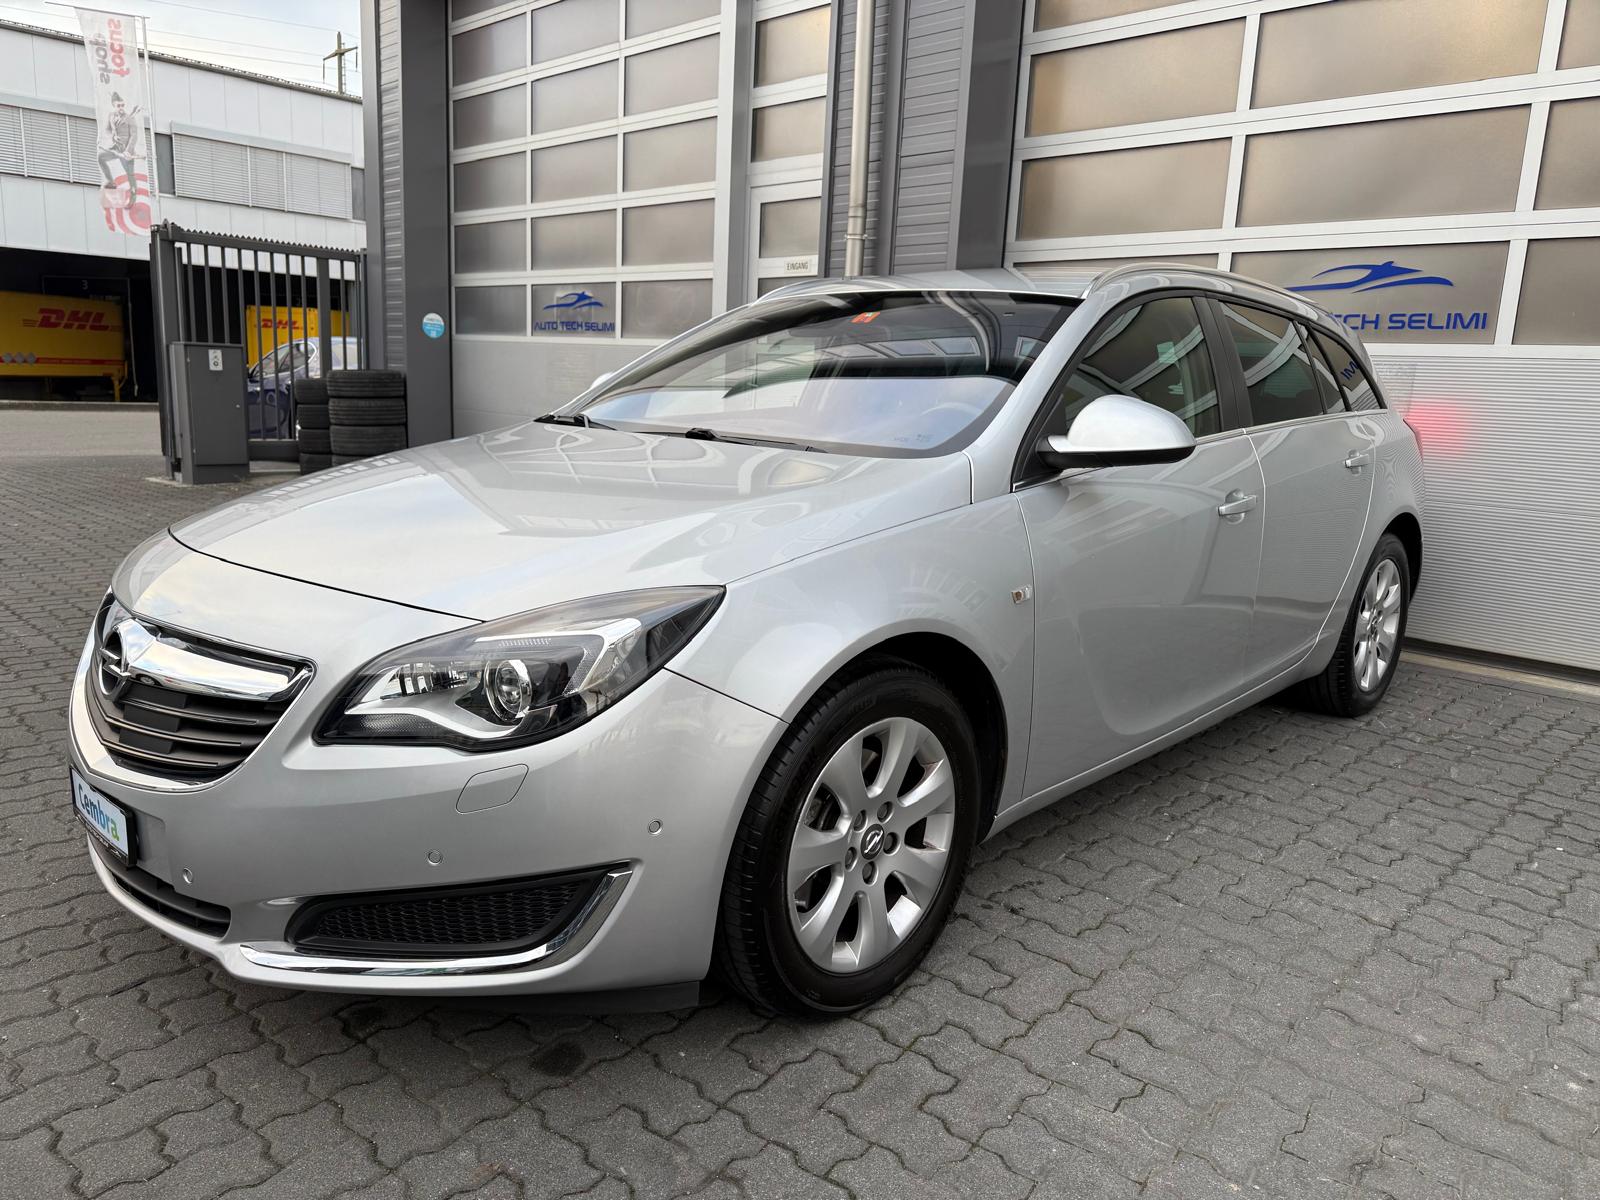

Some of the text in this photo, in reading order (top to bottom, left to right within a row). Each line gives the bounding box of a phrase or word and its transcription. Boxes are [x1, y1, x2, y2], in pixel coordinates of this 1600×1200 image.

[786, 262, 809, 271] EINGANG
[81, 279, 89, 290] 3
[37, 307, 110, 332] DHL
[261, 318, 300, 330] DHL
[1329, 312, 1488, 330] CH SELIMI
[534, 321, 616, 332] AUTO TECH SELIMI
[78, 783, 120, 842] Cembra
